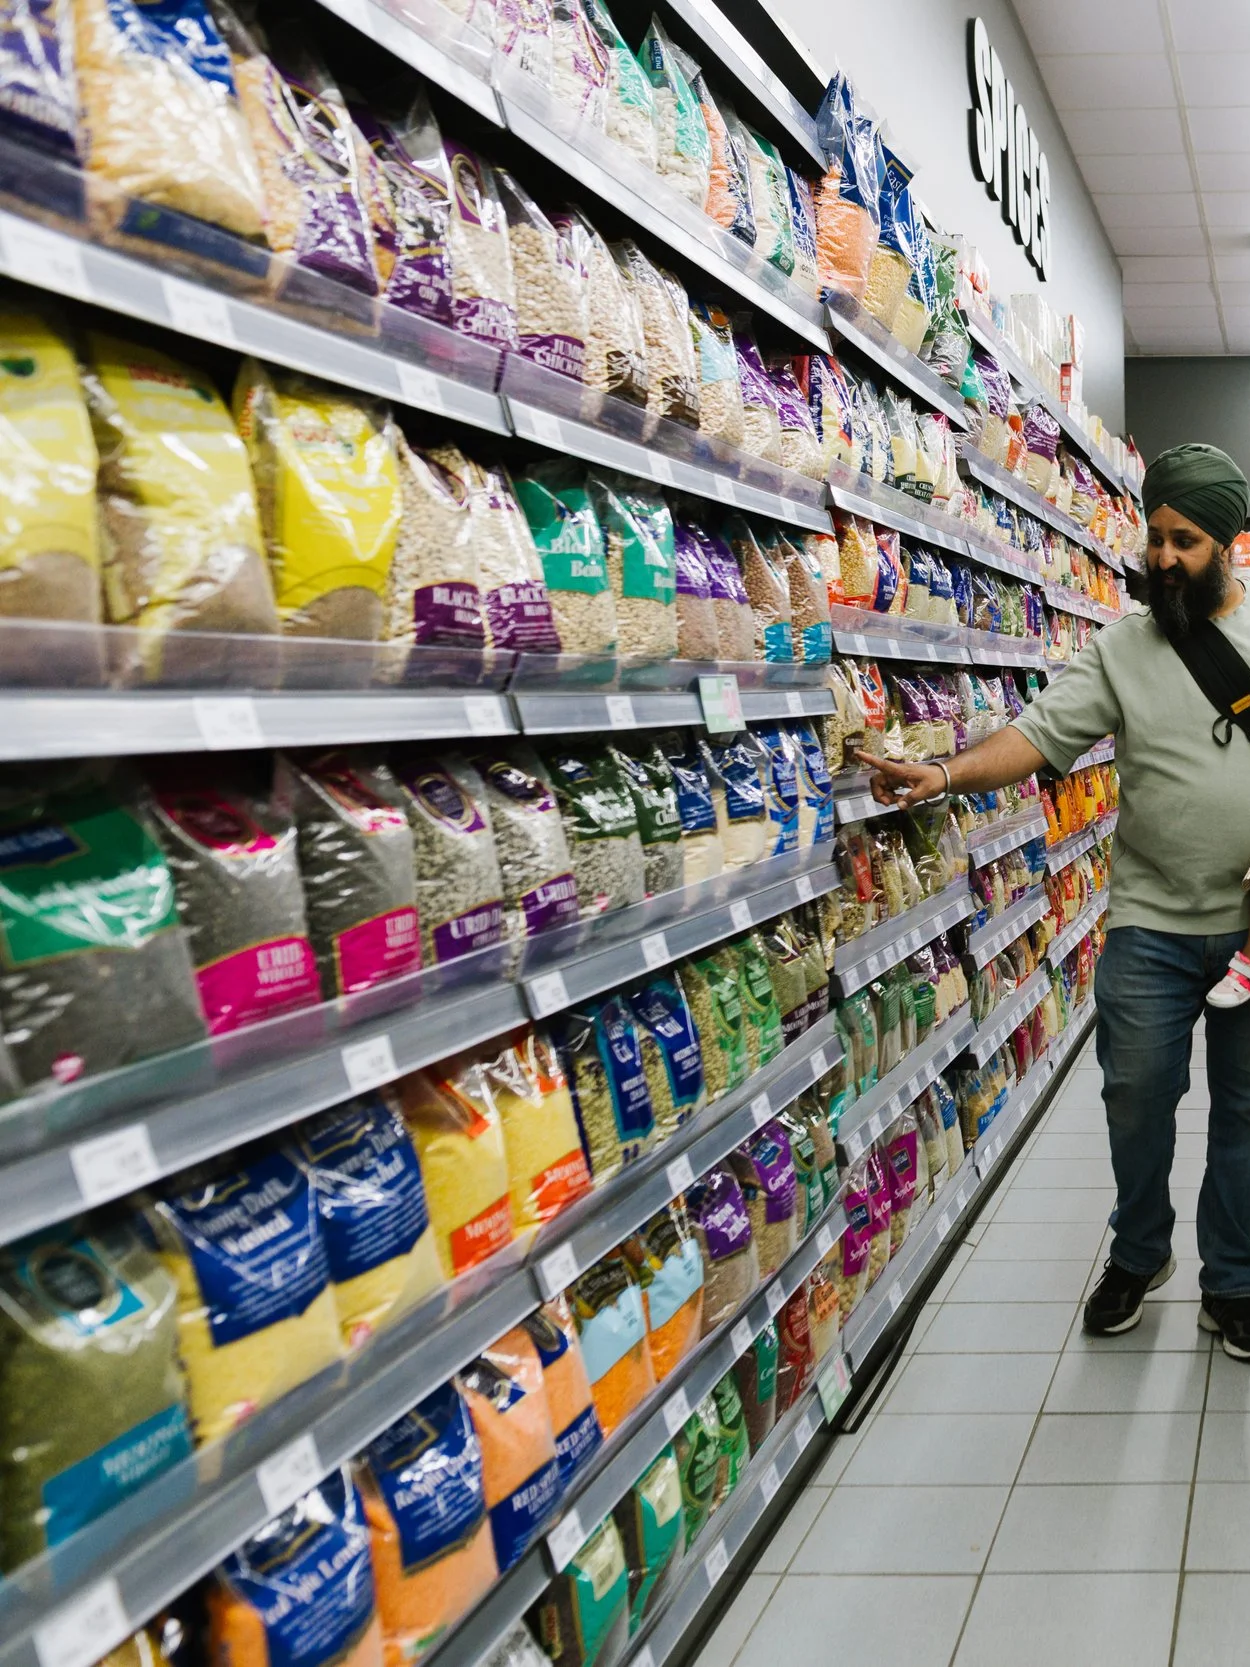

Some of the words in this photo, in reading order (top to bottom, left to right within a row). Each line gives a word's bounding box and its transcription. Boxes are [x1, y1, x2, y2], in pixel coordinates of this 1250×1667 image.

[972, 16, 1050, 282] SPICES
[886, 168, 903, 192] East
[552, 338, 584, 362] JUM
